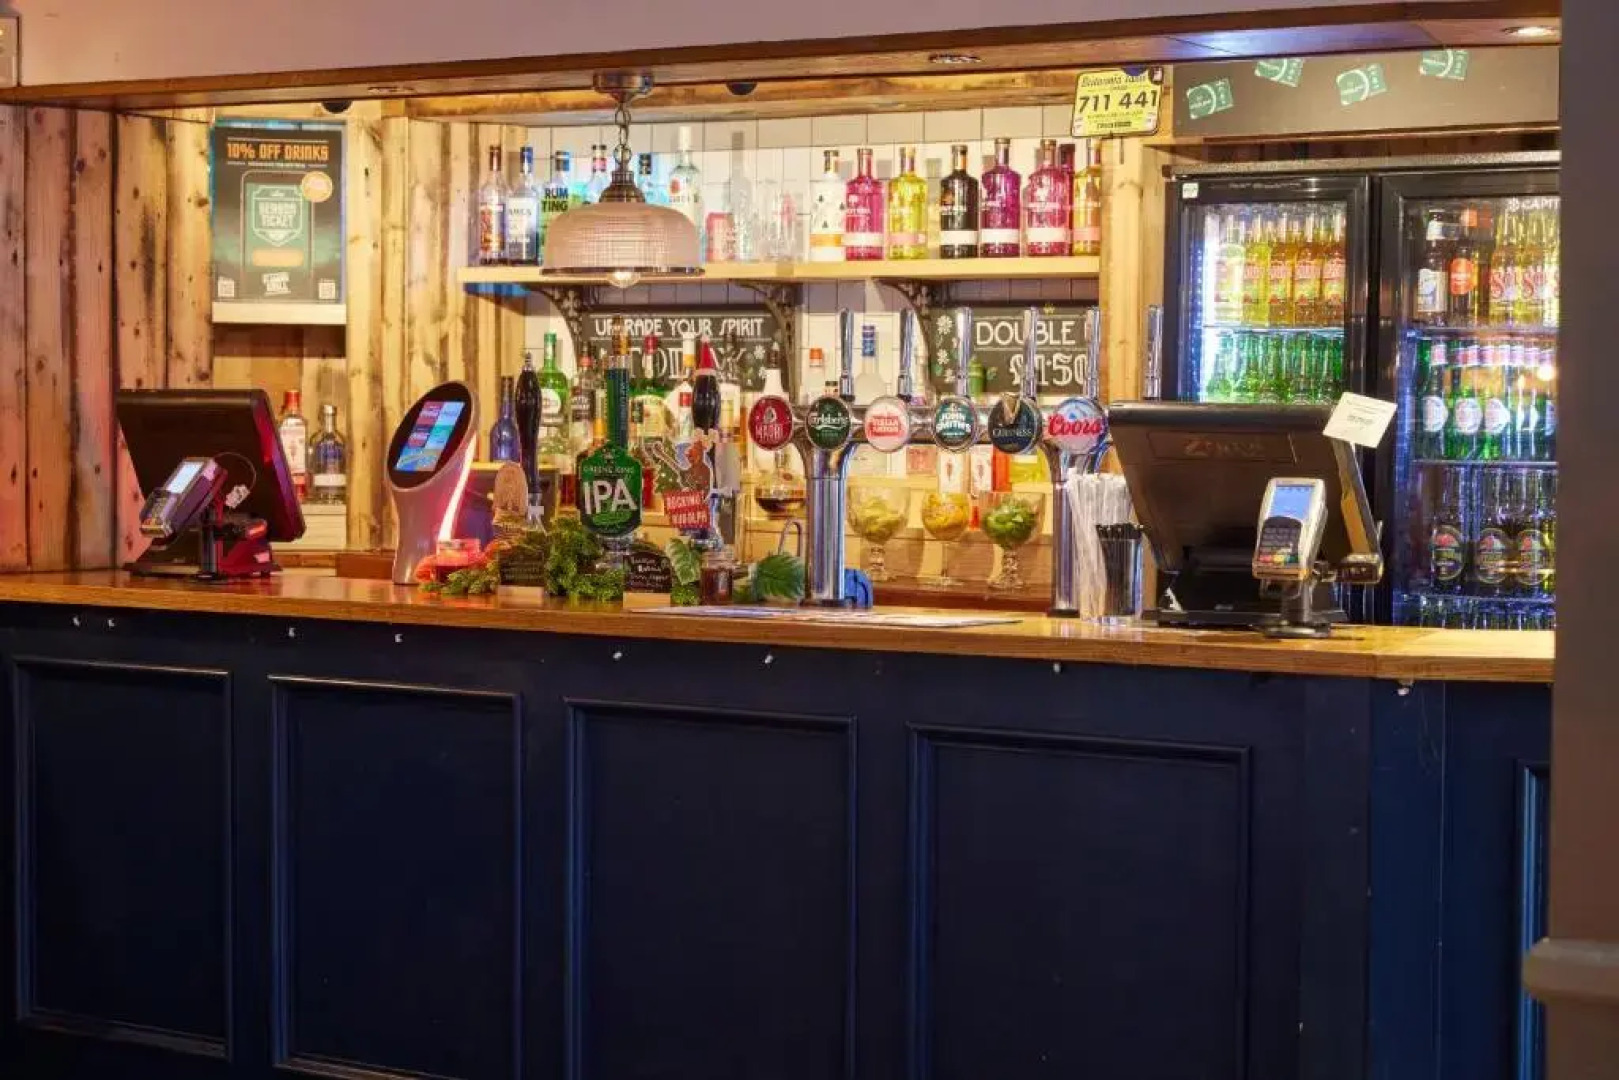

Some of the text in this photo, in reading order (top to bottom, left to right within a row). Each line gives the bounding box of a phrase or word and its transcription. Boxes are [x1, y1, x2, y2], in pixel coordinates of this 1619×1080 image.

[1078, 90, 1158, 113] 711 441
[227, 142, 330, 161] 10% OFF DRINKS
[544, 187, 569, 200] RUM
[541, 200, 568, 213] TING
[595, 317, 765, 337] UPRADE YOUR SPIRIT
[976, 320, 1076, 346] DOUBLE
[1047, 414, 1103, 437] Coors
[582, 478, 638, 515] IPA
